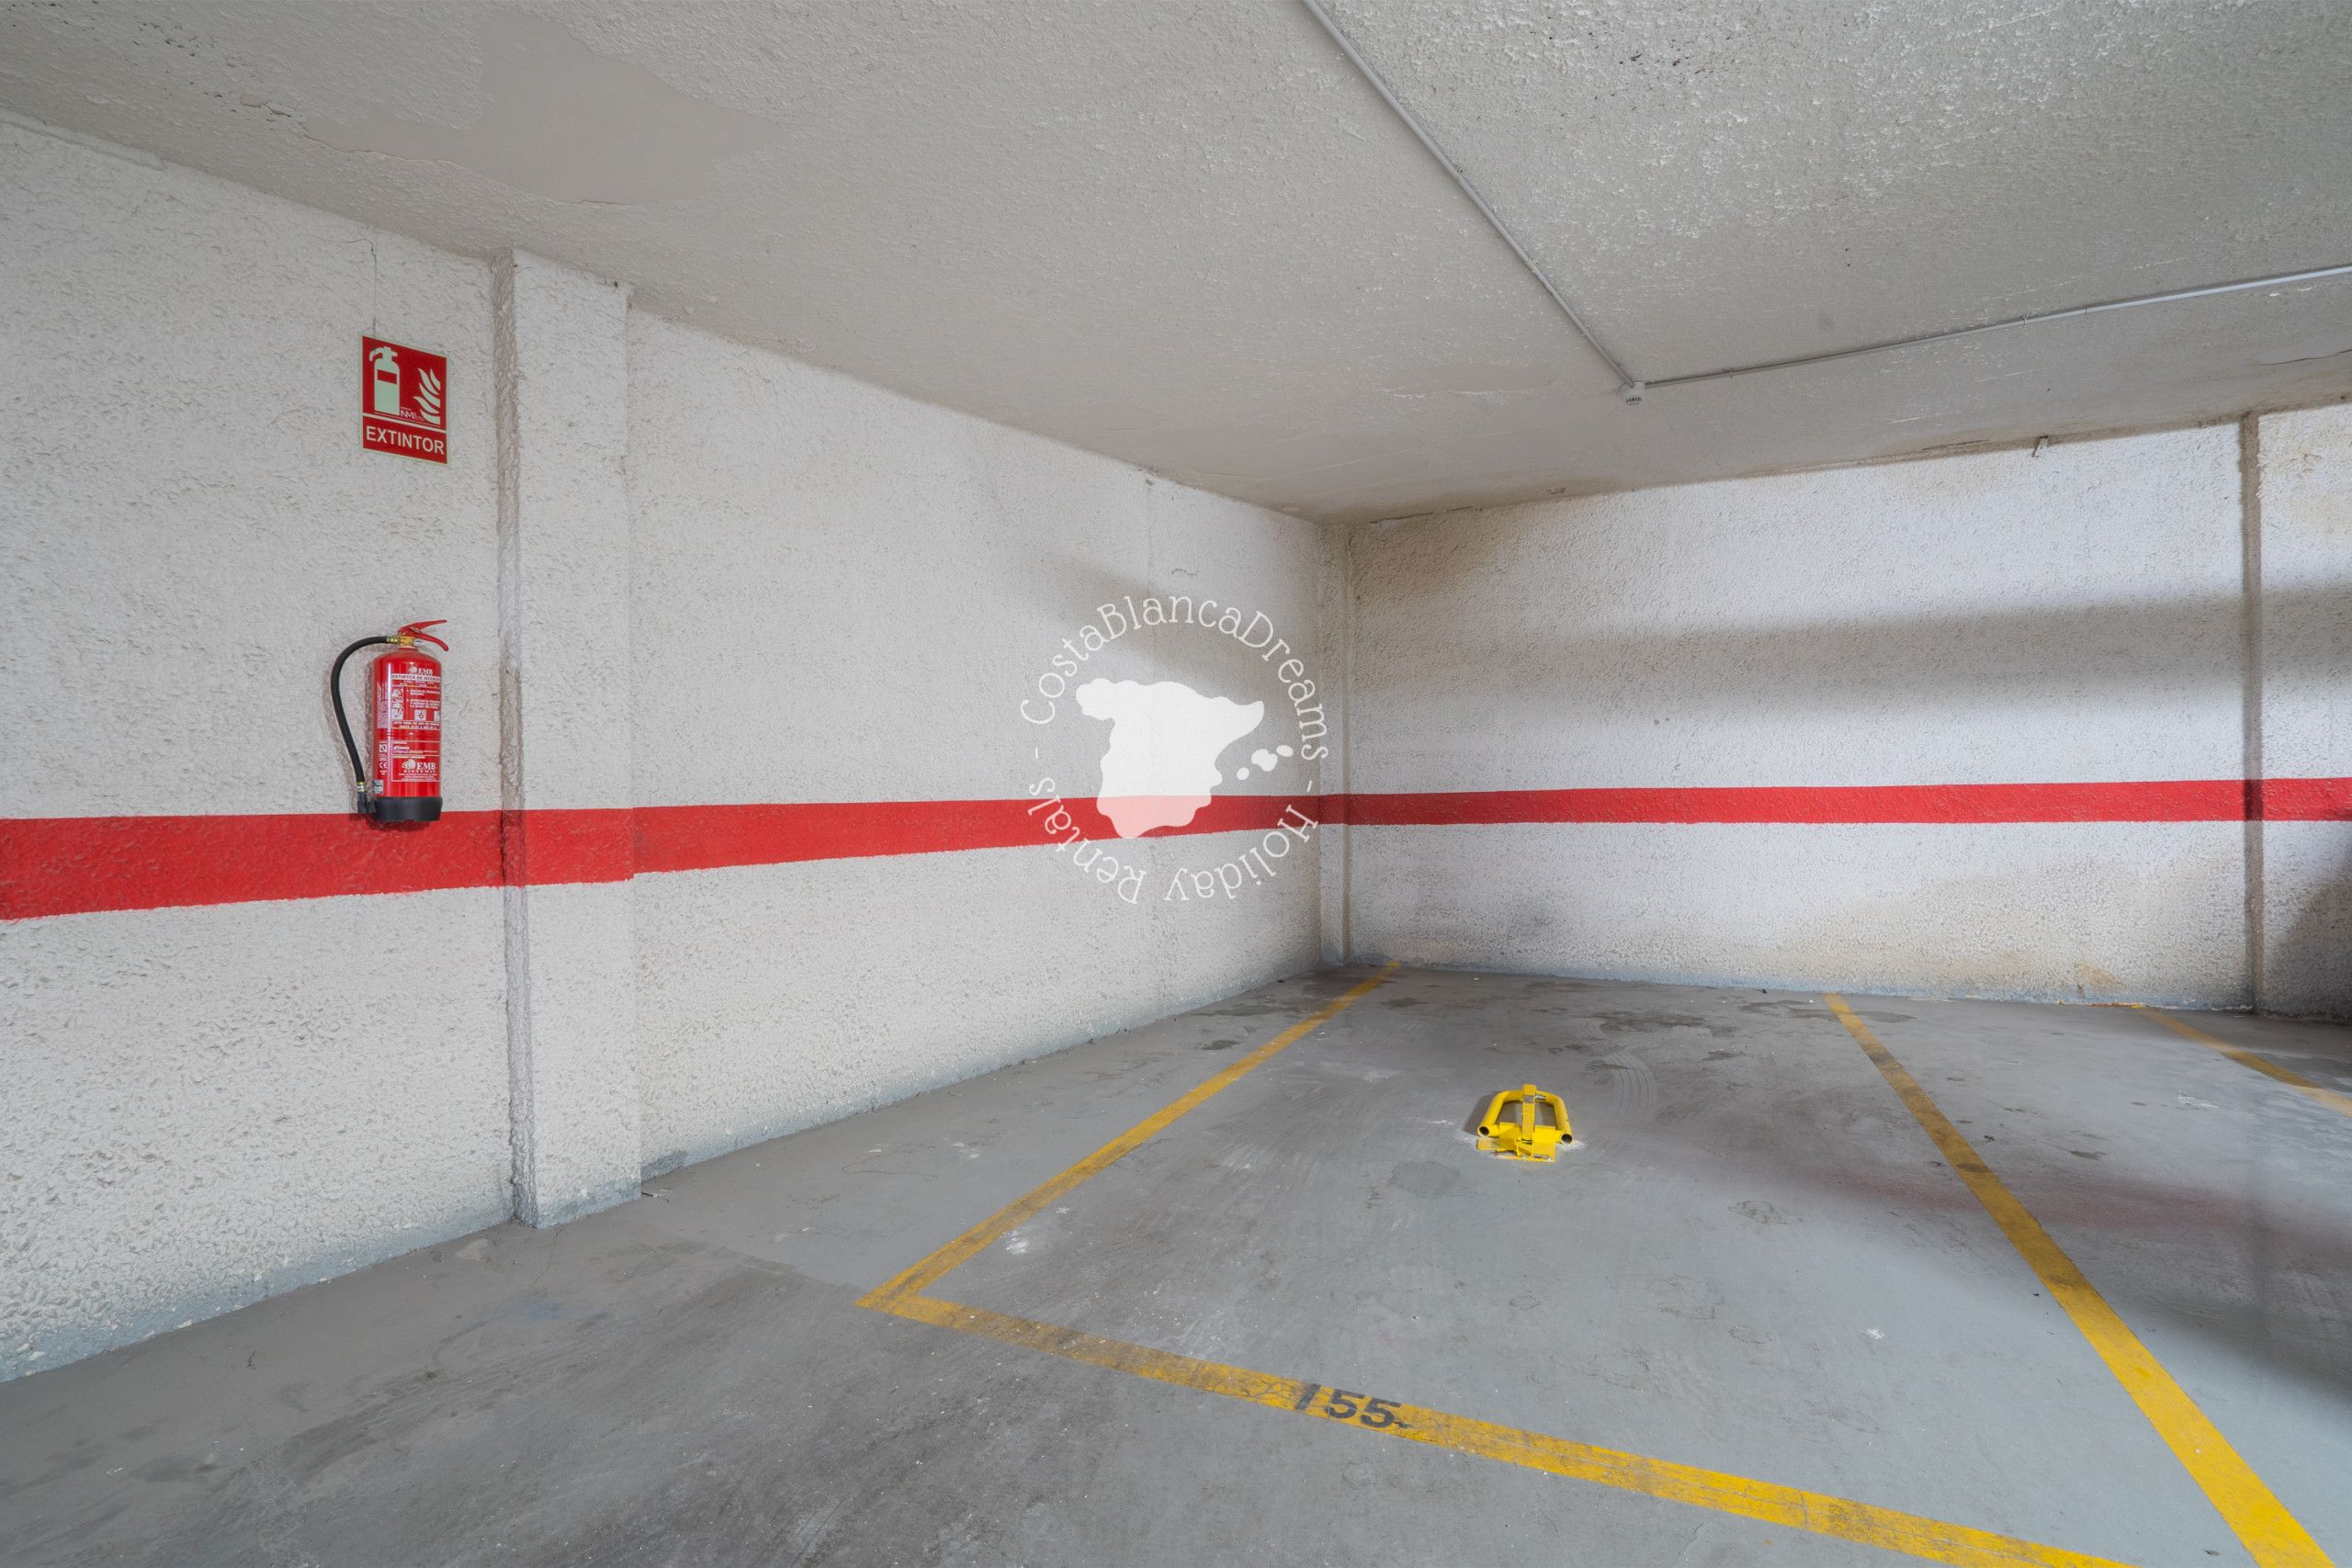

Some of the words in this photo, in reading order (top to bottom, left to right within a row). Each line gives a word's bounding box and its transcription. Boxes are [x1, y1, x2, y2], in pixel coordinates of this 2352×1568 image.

[366, 425, 445, 455] EXTINTOR
[416, 761, 436, 770] EMB
[1294, 1382, 1402, 1428] 155
